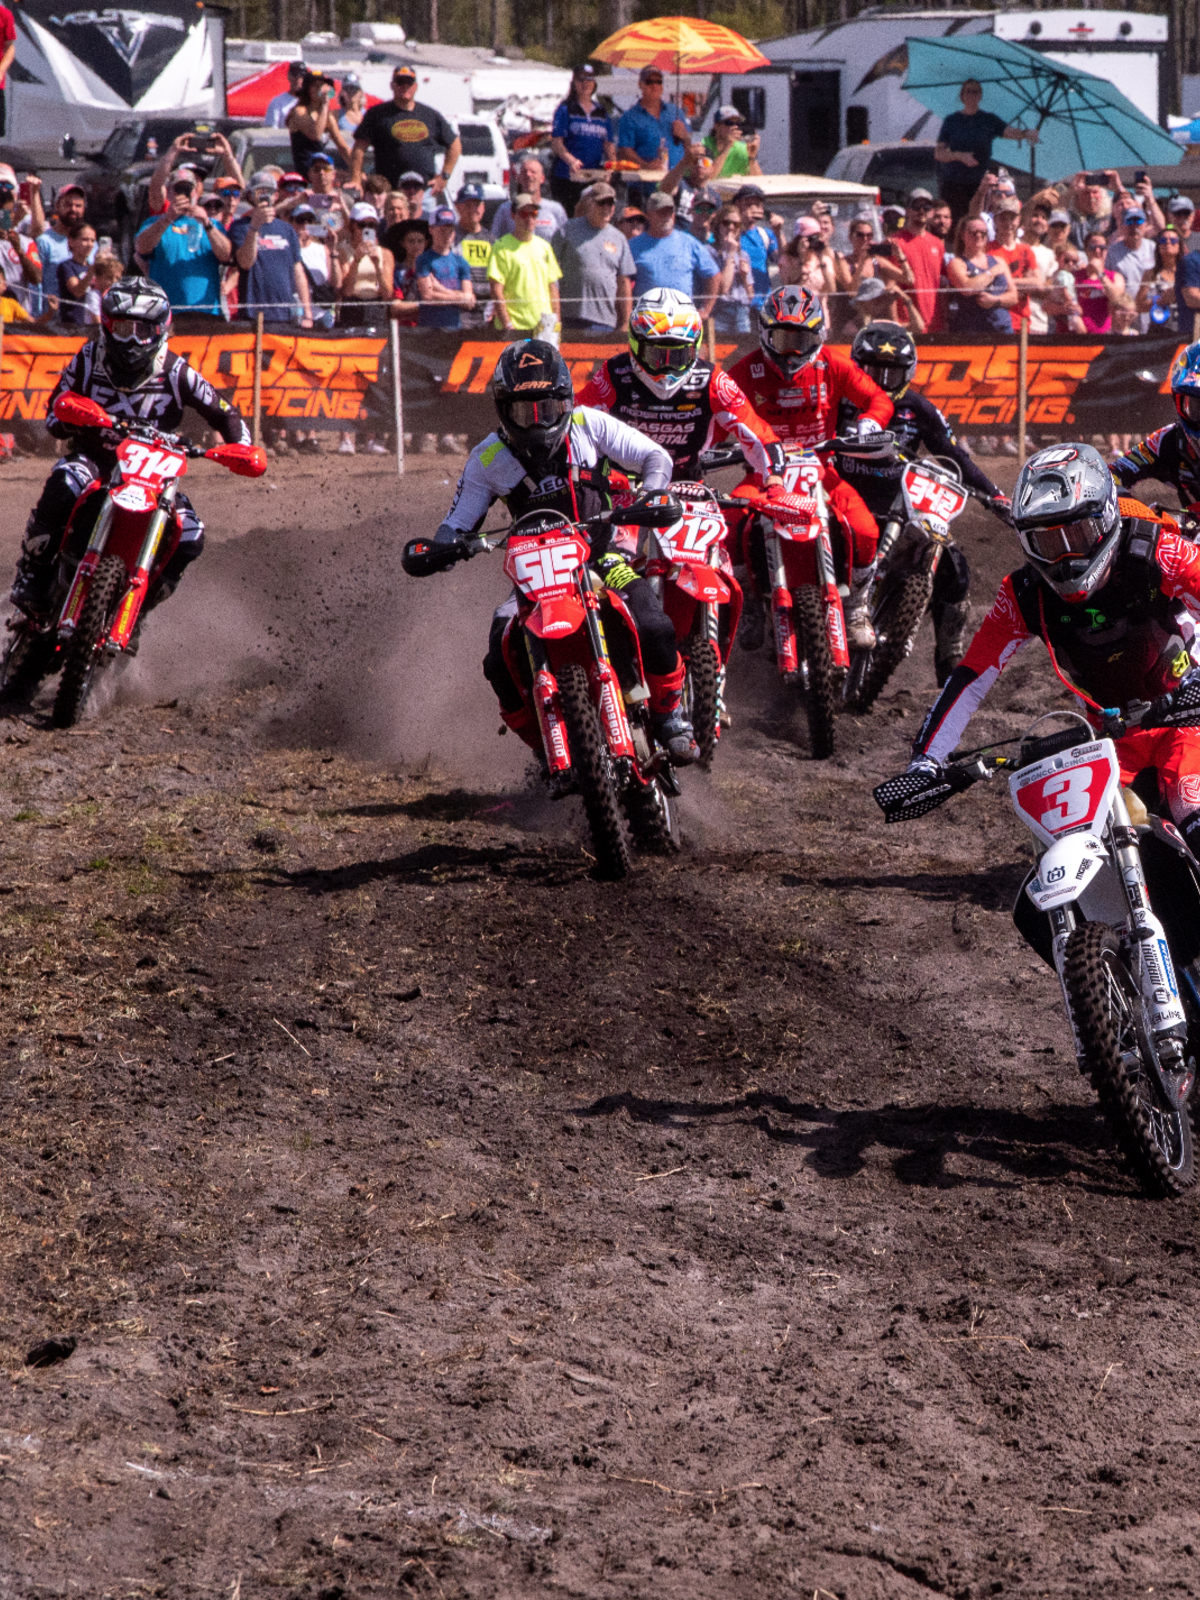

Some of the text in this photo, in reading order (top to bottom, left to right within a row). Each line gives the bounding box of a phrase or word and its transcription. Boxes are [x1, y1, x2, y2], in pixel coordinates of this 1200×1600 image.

[468, 244, 487, 257] FLY
[912, 345, 1104, 396] OSE
[231, 388, 364, 419] RACING
[120, 443, 184, 479] 314
[648, 434, 689, 445] ASTAL
[908, 475, 959, 521] 342
[514, 543, 580, 593] 515
[544, 696, 565, 757] CBEQUID
[603, 685, 622, 745] COBEQUID
[1031, 753, 1102, 781] GNCCCING.COM
[1041, 766, 1093, 832] 3
